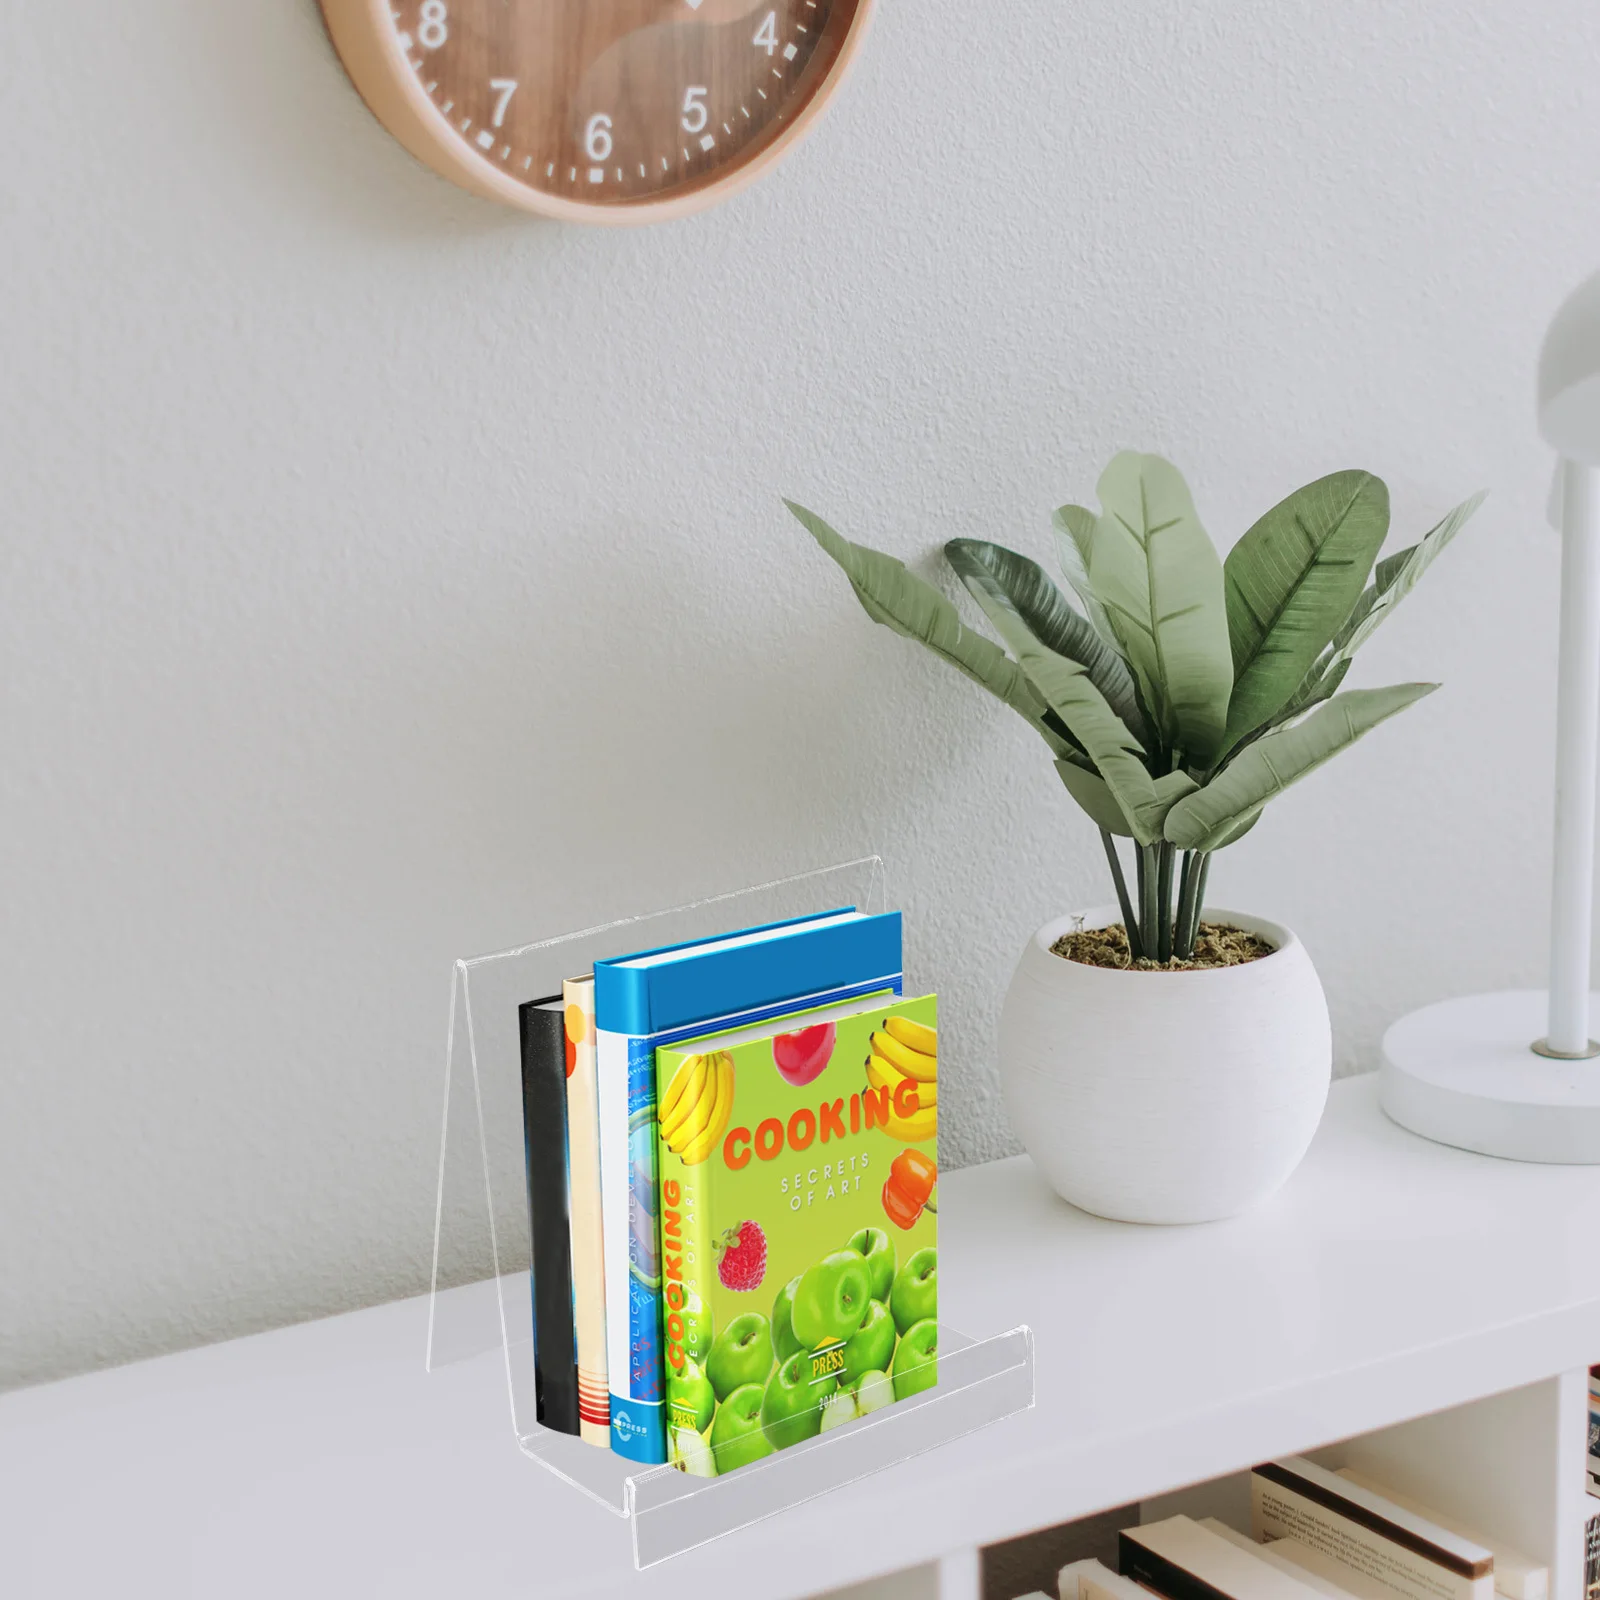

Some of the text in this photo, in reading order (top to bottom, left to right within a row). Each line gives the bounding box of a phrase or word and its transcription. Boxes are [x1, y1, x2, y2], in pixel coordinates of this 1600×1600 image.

[418, 0, 448, 48] 8
[753, 12, 778, 56] 4
[489, 79, 518, 127] 7
[682, 87, 708, 132] 5
[585, 115, 613, 161] 6
[722, 1077, 919, 1171] COOKING
[781, 1152, 870, 1194] SECRETS
[790, 1174, 862, 1212] OF ART
[684, 1184, 695, 1224] ART
[685, 1238, 696, 1264] OF
[663, 1179, 684, 1370] COOKING
[812, 1348, 845, 1378] PRESS
[673, 1409, 697, 1431] PRESS
